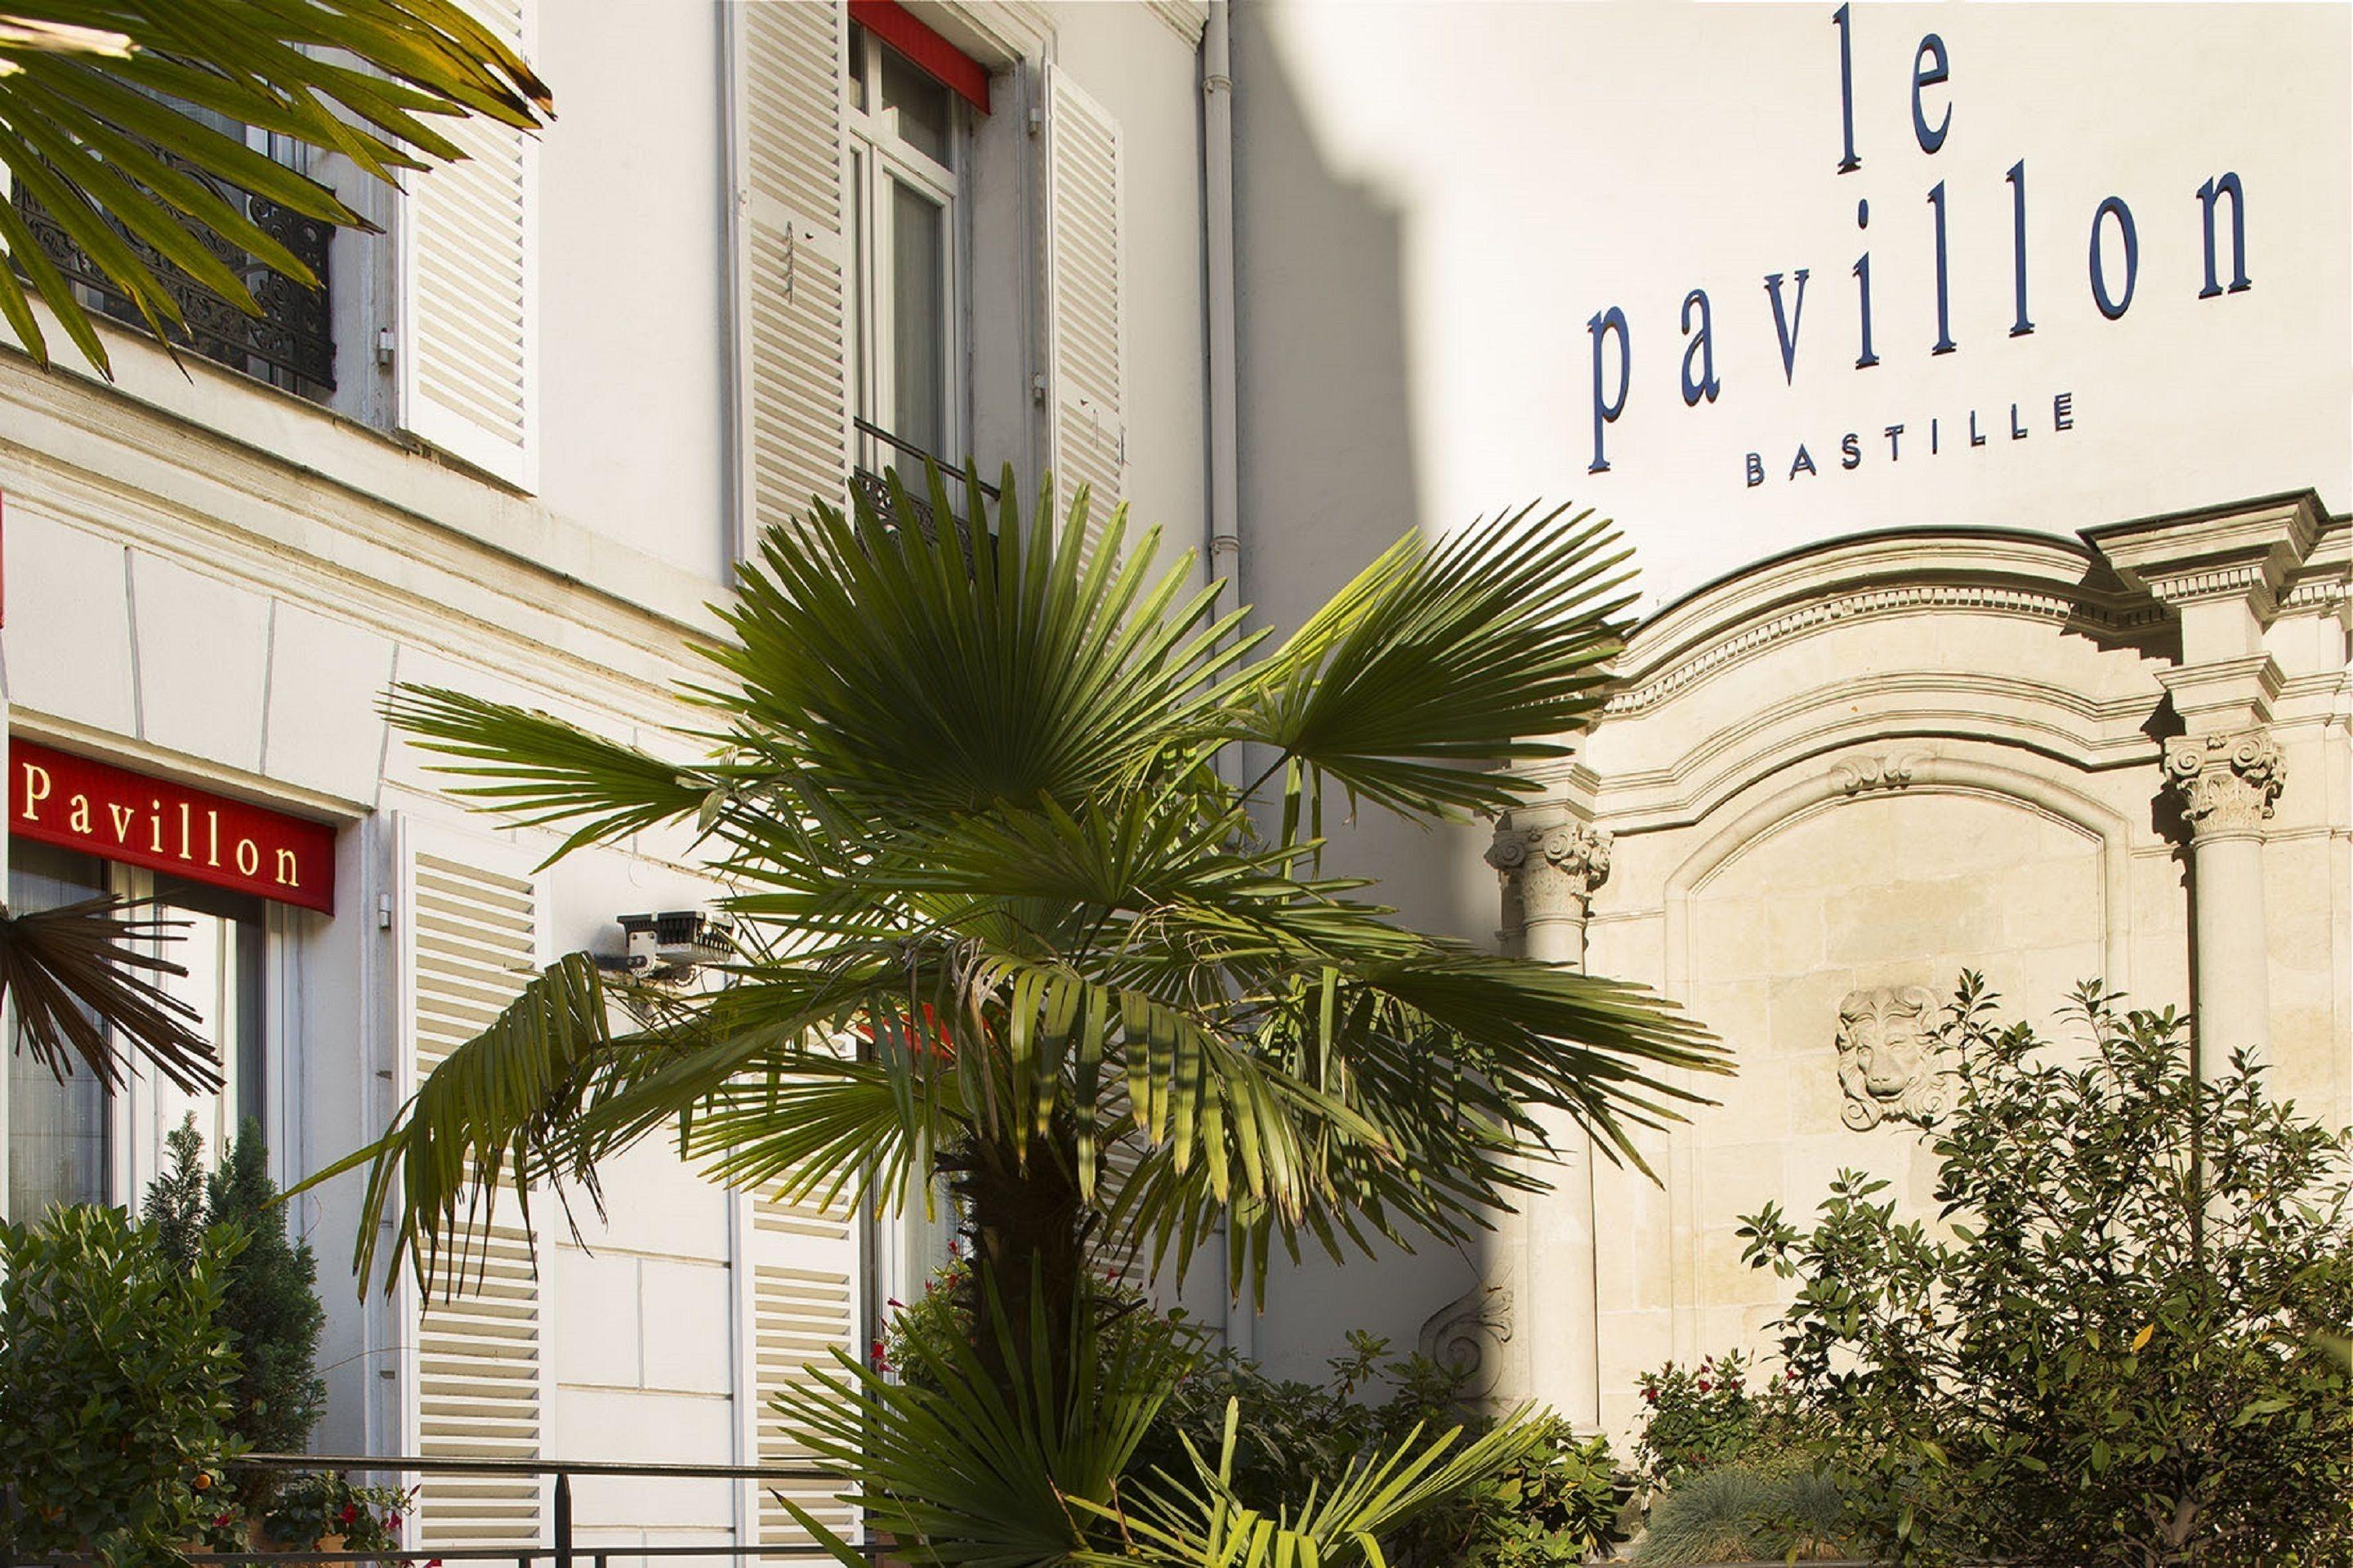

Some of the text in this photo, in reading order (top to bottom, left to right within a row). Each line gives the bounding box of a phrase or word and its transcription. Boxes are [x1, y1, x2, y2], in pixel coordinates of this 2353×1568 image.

[1833, 2, 1952, 173] le
[1587, 159, 2252, 473] pavillon
[1746, 392, 2074, 488] BASTILLE
[22, 762, 300, 887] Pavillon
